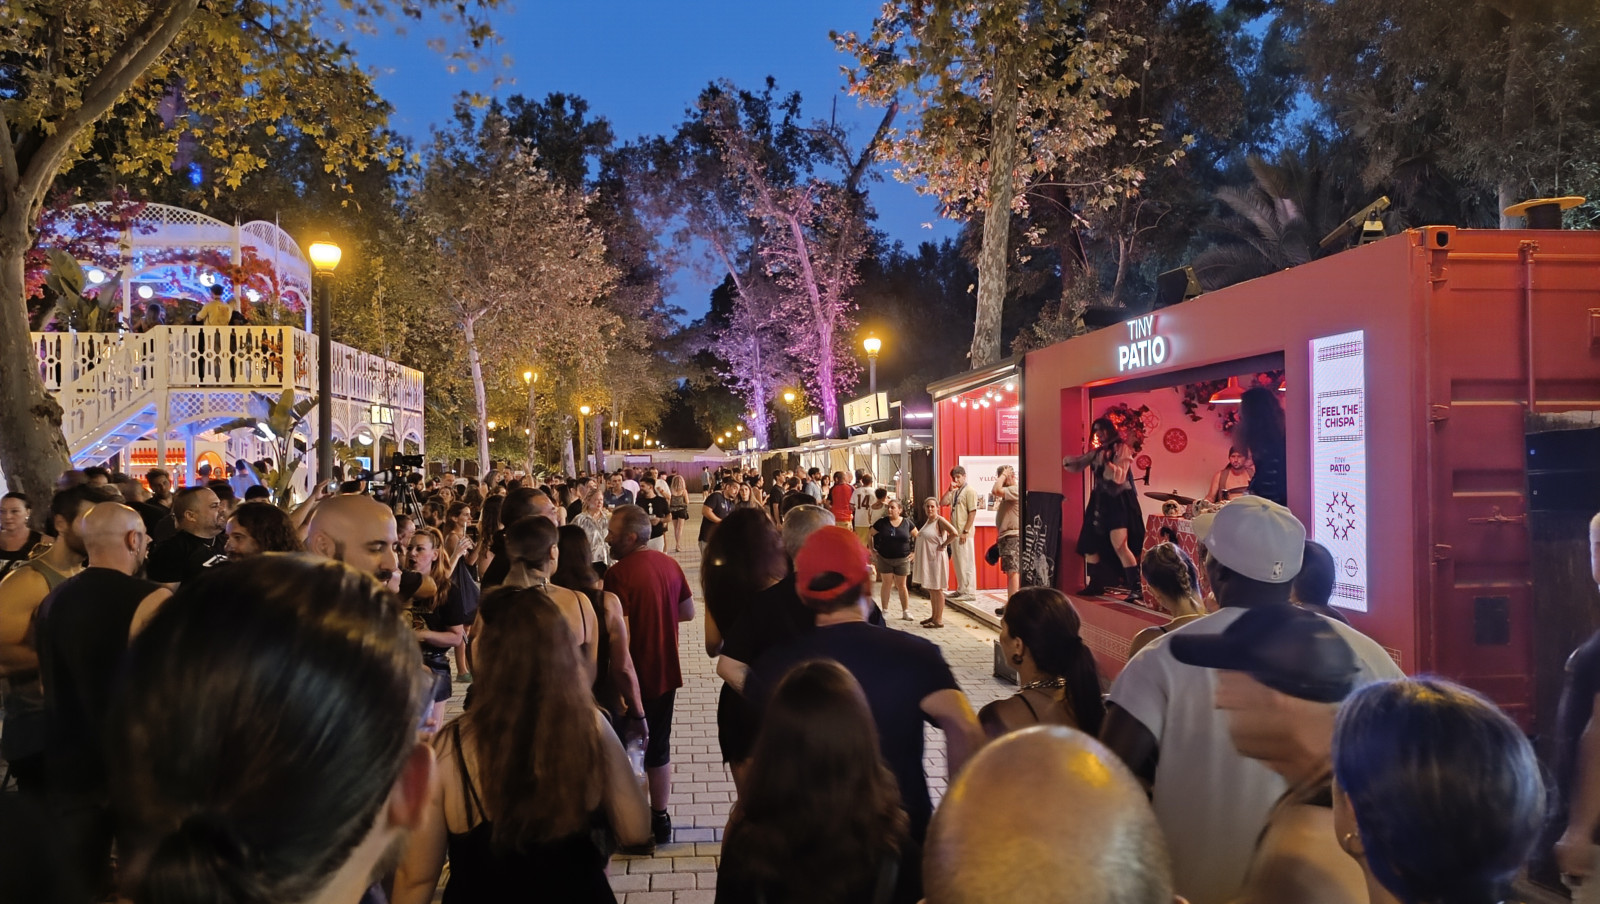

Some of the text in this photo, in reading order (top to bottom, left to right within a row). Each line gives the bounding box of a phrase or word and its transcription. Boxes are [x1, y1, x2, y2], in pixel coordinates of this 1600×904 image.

[1127, 315, 1153, 340] TINY
[1119, 336, 1165, 371] PATIO
[1321, 404, 1358, 416] FEEL THE
[1325, 417, 1355, 428] CHISPA
[1330, 464, 1350, 472] PATIO
[857, 494, 870, 510] 14
